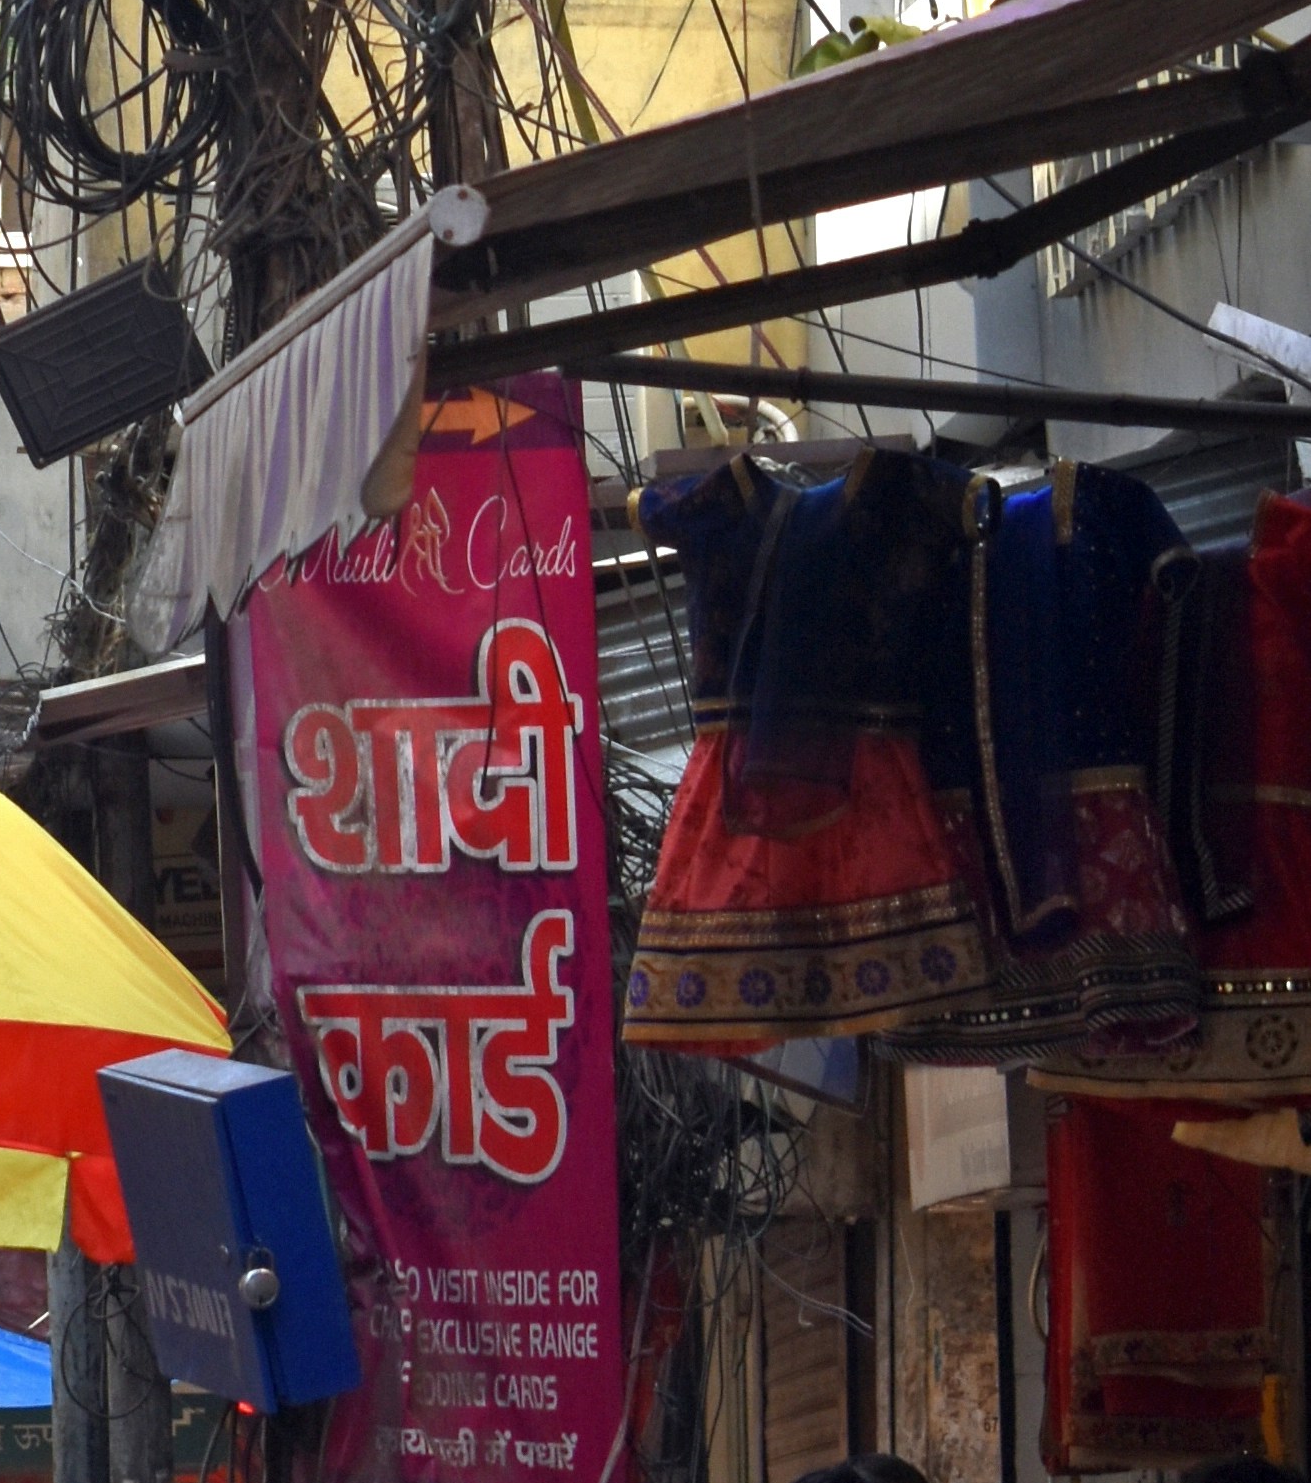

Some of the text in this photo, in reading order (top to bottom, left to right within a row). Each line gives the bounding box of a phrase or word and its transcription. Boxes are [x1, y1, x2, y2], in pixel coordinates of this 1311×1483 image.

[467, 495, 576, 590] Cards
[283, 616, 583, 876] शादी
[295, 909, 576, 1185] कार्ड
[427, 1267, 478, 1304] VISIT
[483, 1269, 551, 1306] INSIDE
[557, 1269, 599, 1306] FOR
[416, 1318, 523, 1358] EXCLUSIVE
[529, 1322, 599, 1358] RANGE
[493, 1374, 558, 1411] CARDS
